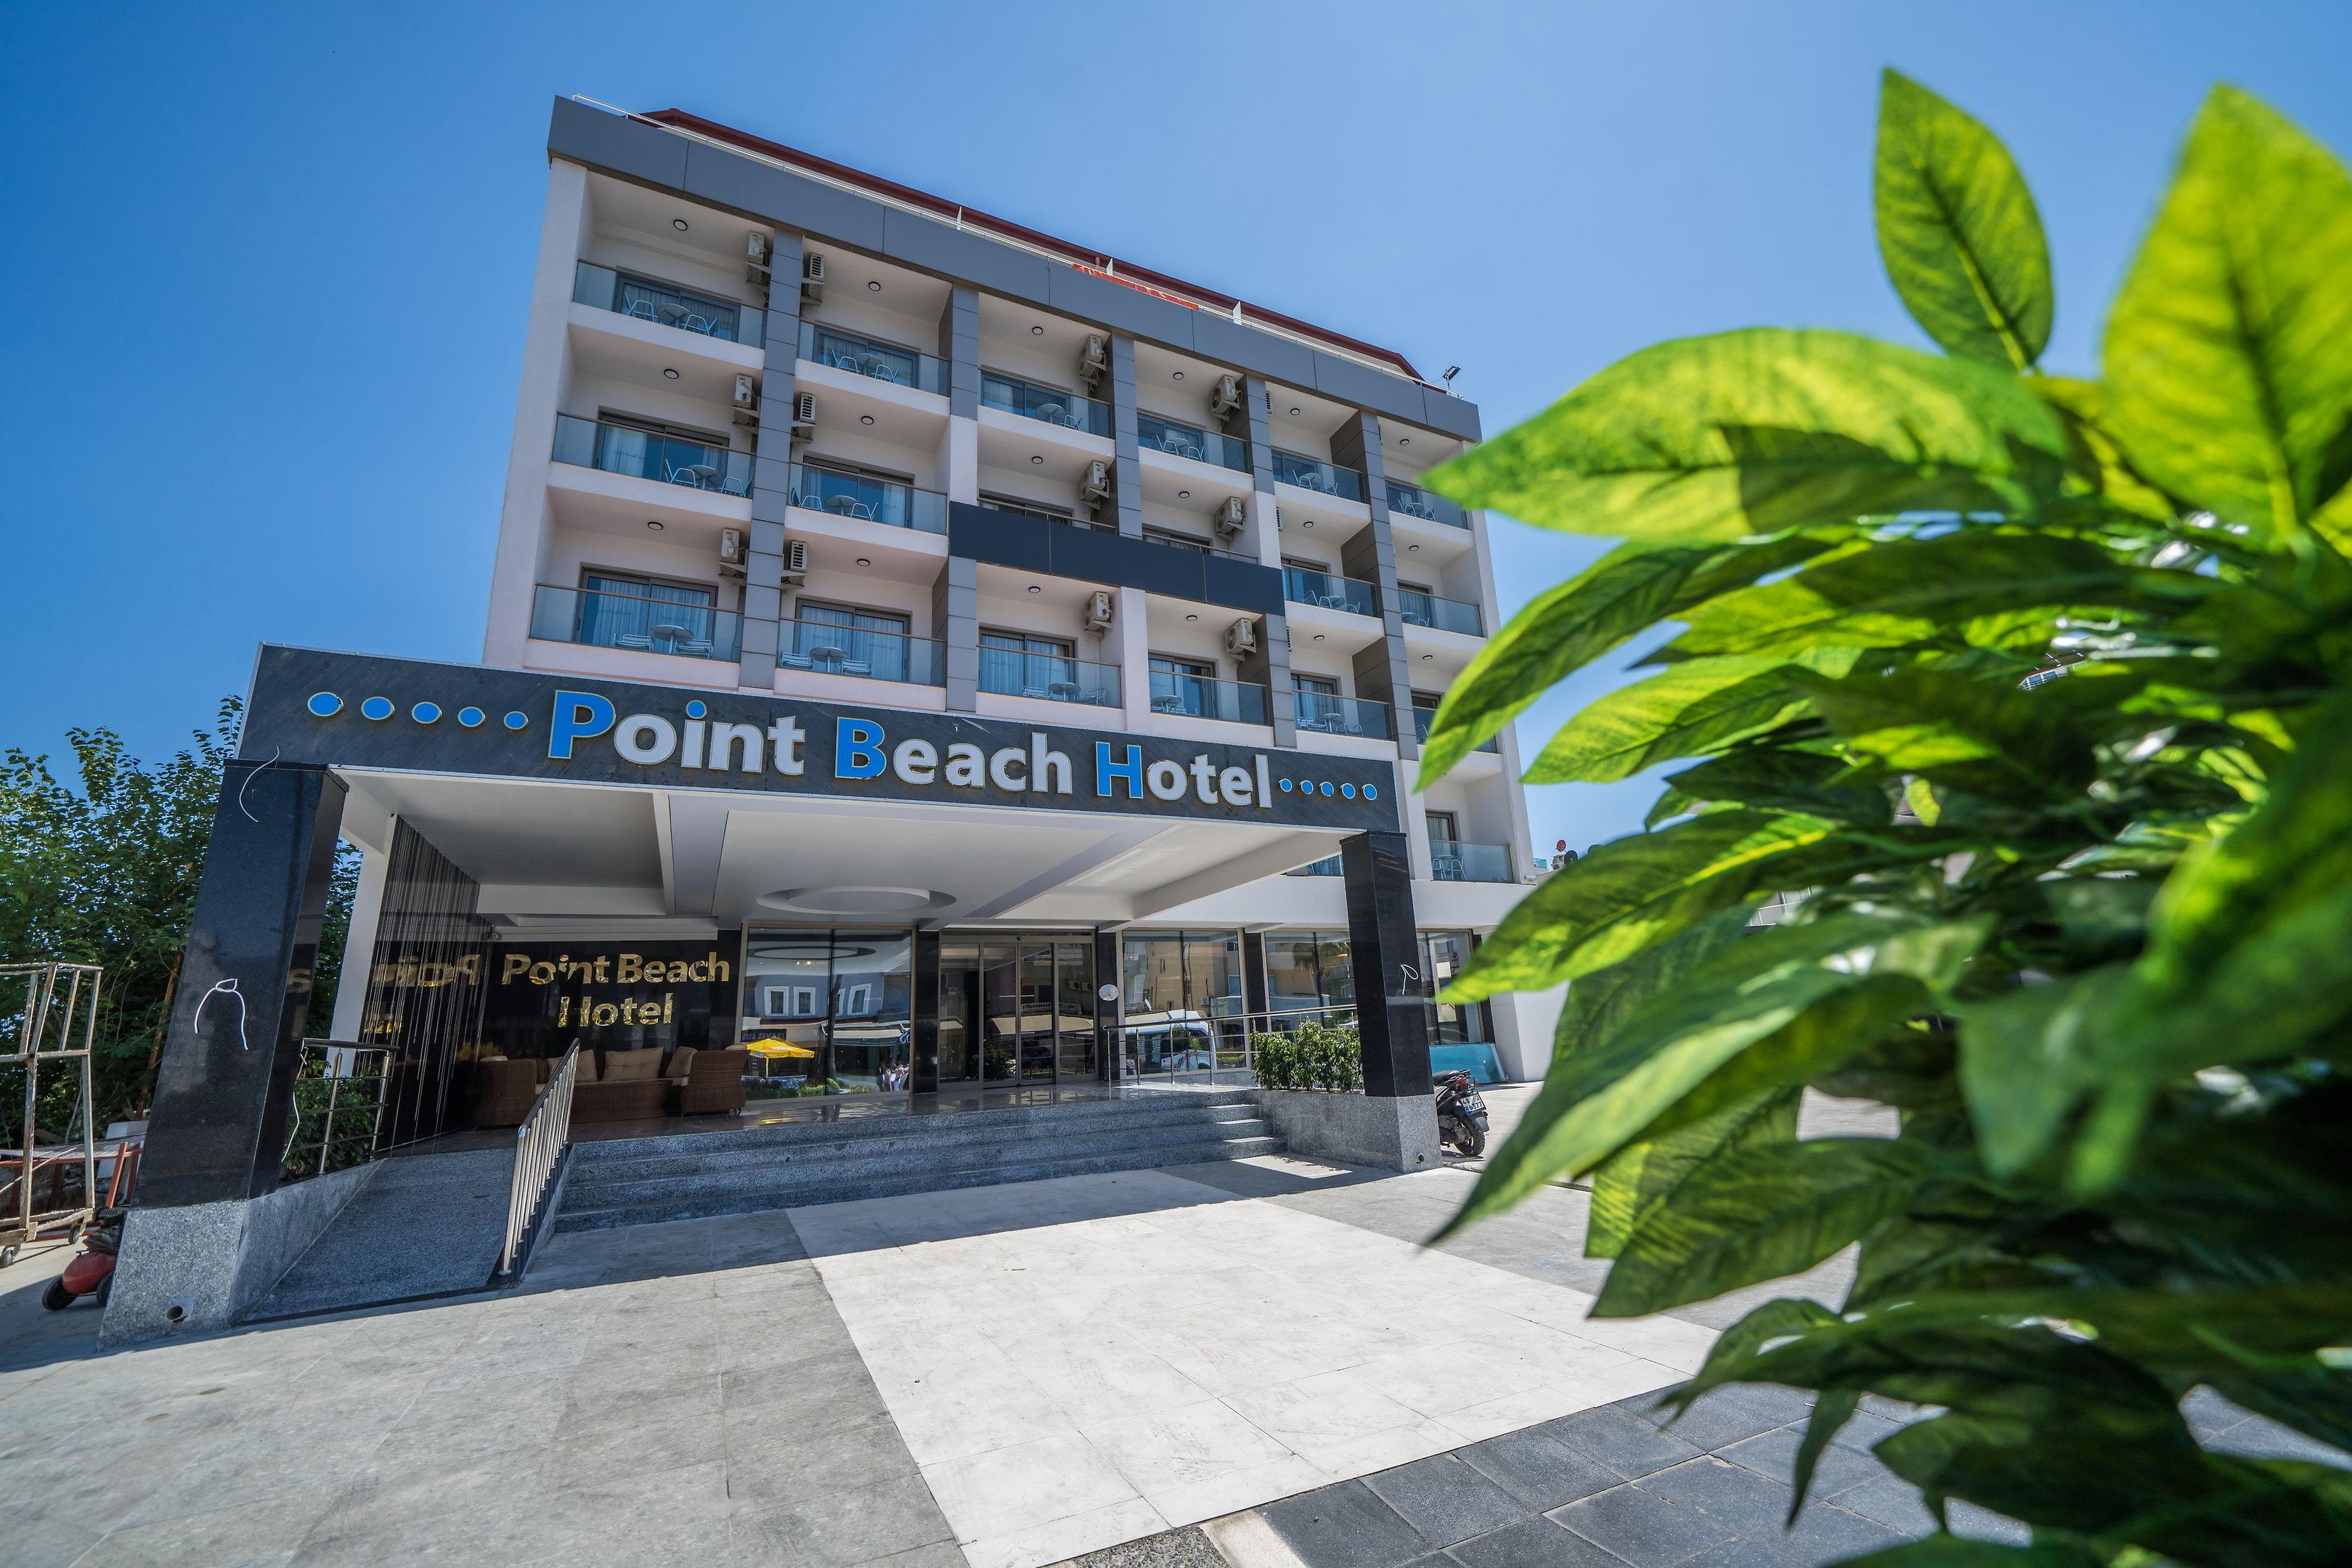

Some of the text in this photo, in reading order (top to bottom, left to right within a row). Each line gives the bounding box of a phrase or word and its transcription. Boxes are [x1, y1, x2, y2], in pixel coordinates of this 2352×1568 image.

[548, 690, 1272, 809] Point Beach Hotel
[502, 952, 730, 984] Point Beach
[558, 993, 674, 1028] Hotel
[1469, 1101, 1482, 1110] 6377
